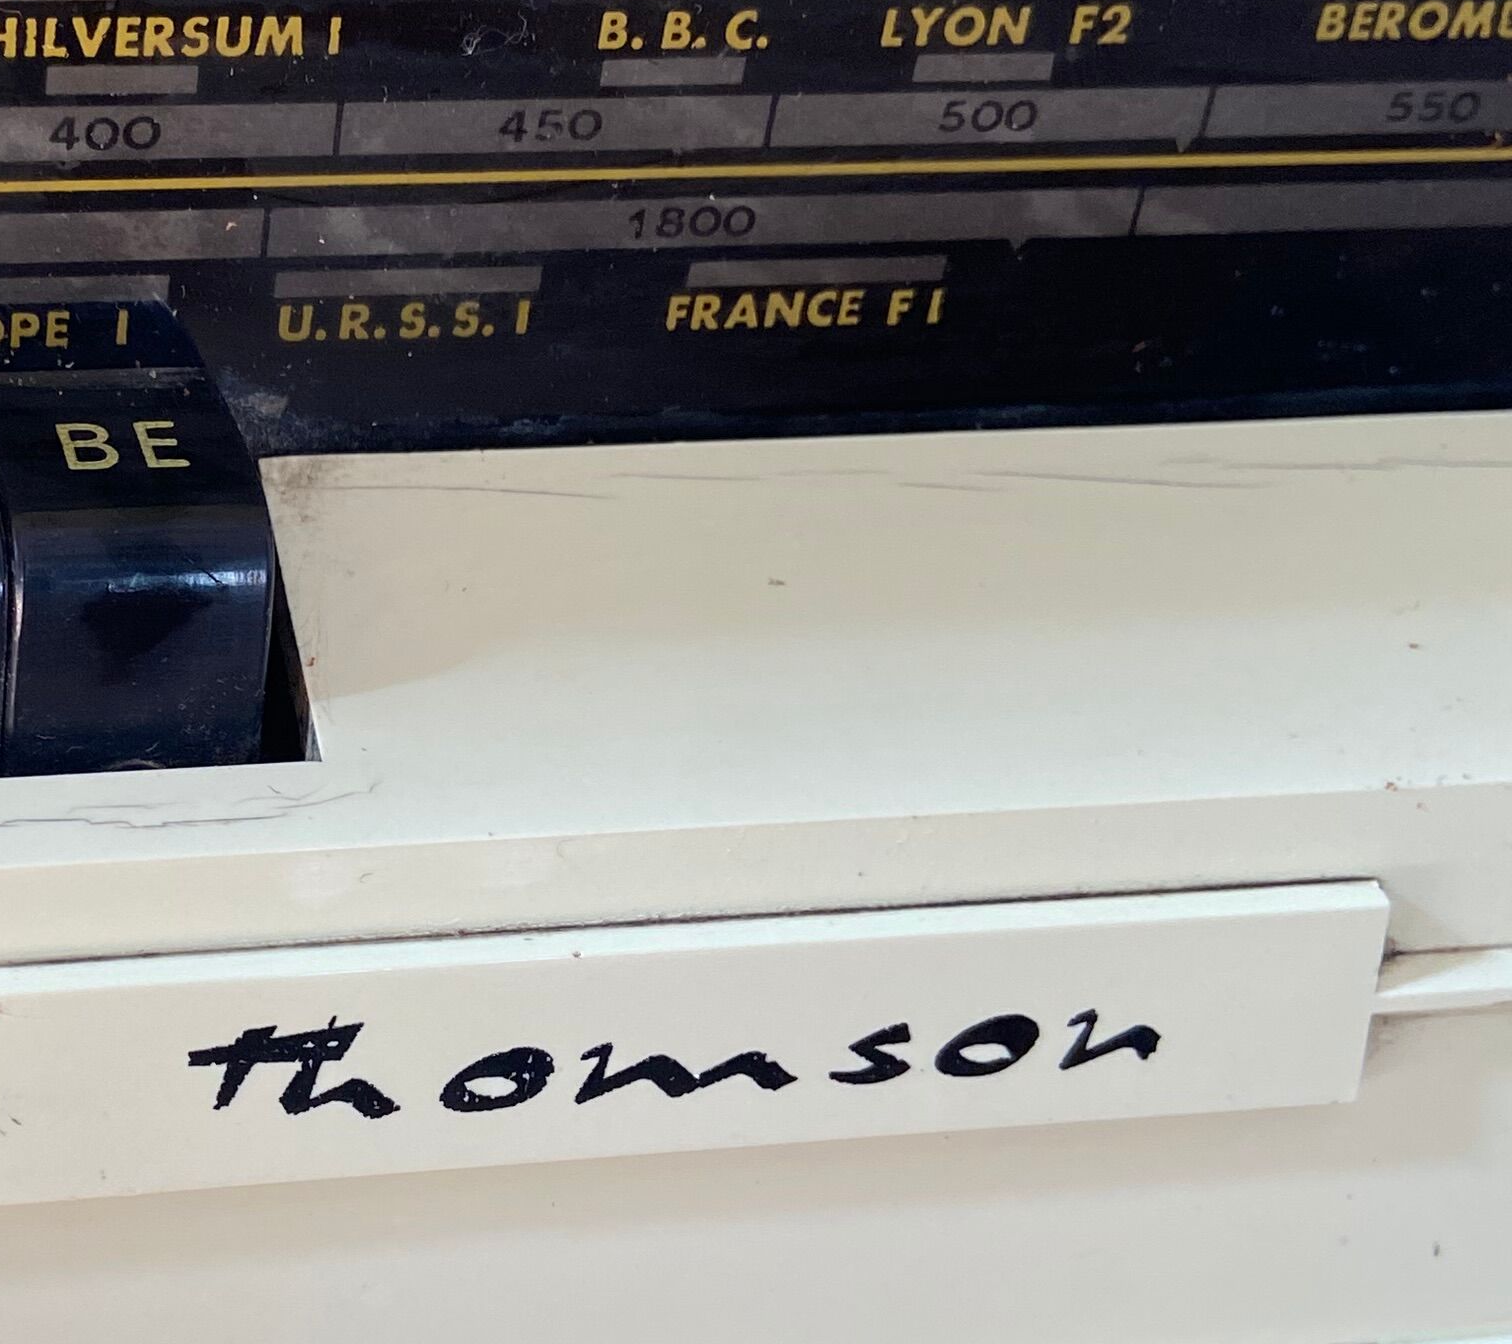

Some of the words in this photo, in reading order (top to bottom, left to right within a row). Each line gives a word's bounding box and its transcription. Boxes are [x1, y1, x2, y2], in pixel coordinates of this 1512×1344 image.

[880, 6, 1032, 49] LYON
[1069, 4, 1132, 46] F2
[937, 99, 1039, 133] 500
[1387, 90, 1482, 124] 550
[48, 115, 162, 152] 400
[498, 108, 604, 144] 450
[628, 203, 757, 240] 1800
[665, 288, 861, 331] FRANCE
[55, 419, 191, 471] BE
